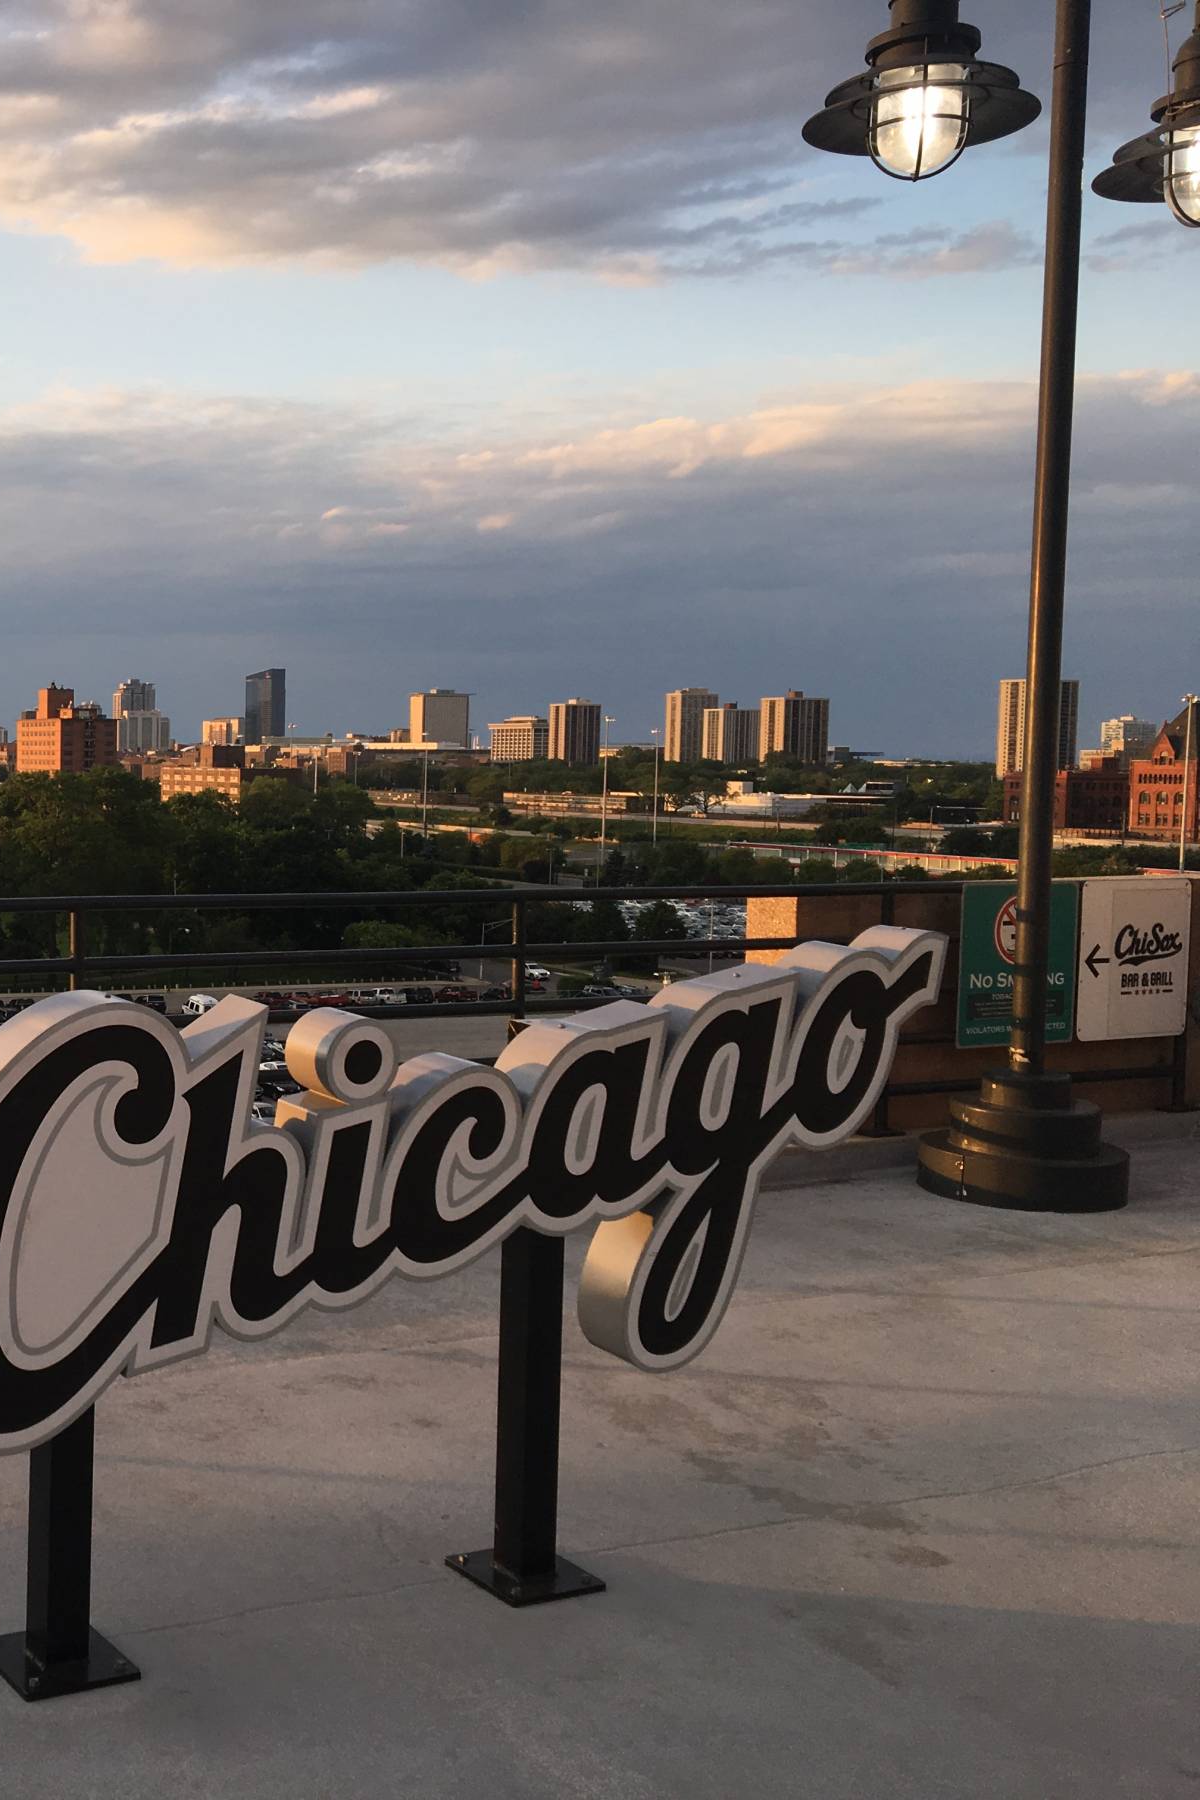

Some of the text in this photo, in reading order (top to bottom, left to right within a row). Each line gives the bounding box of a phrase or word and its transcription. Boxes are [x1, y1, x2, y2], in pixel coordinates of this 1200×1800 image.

[1115, 922, 1183, 960] ChiSox
[1121, 971, 1173, 988] BAR & GRILL
